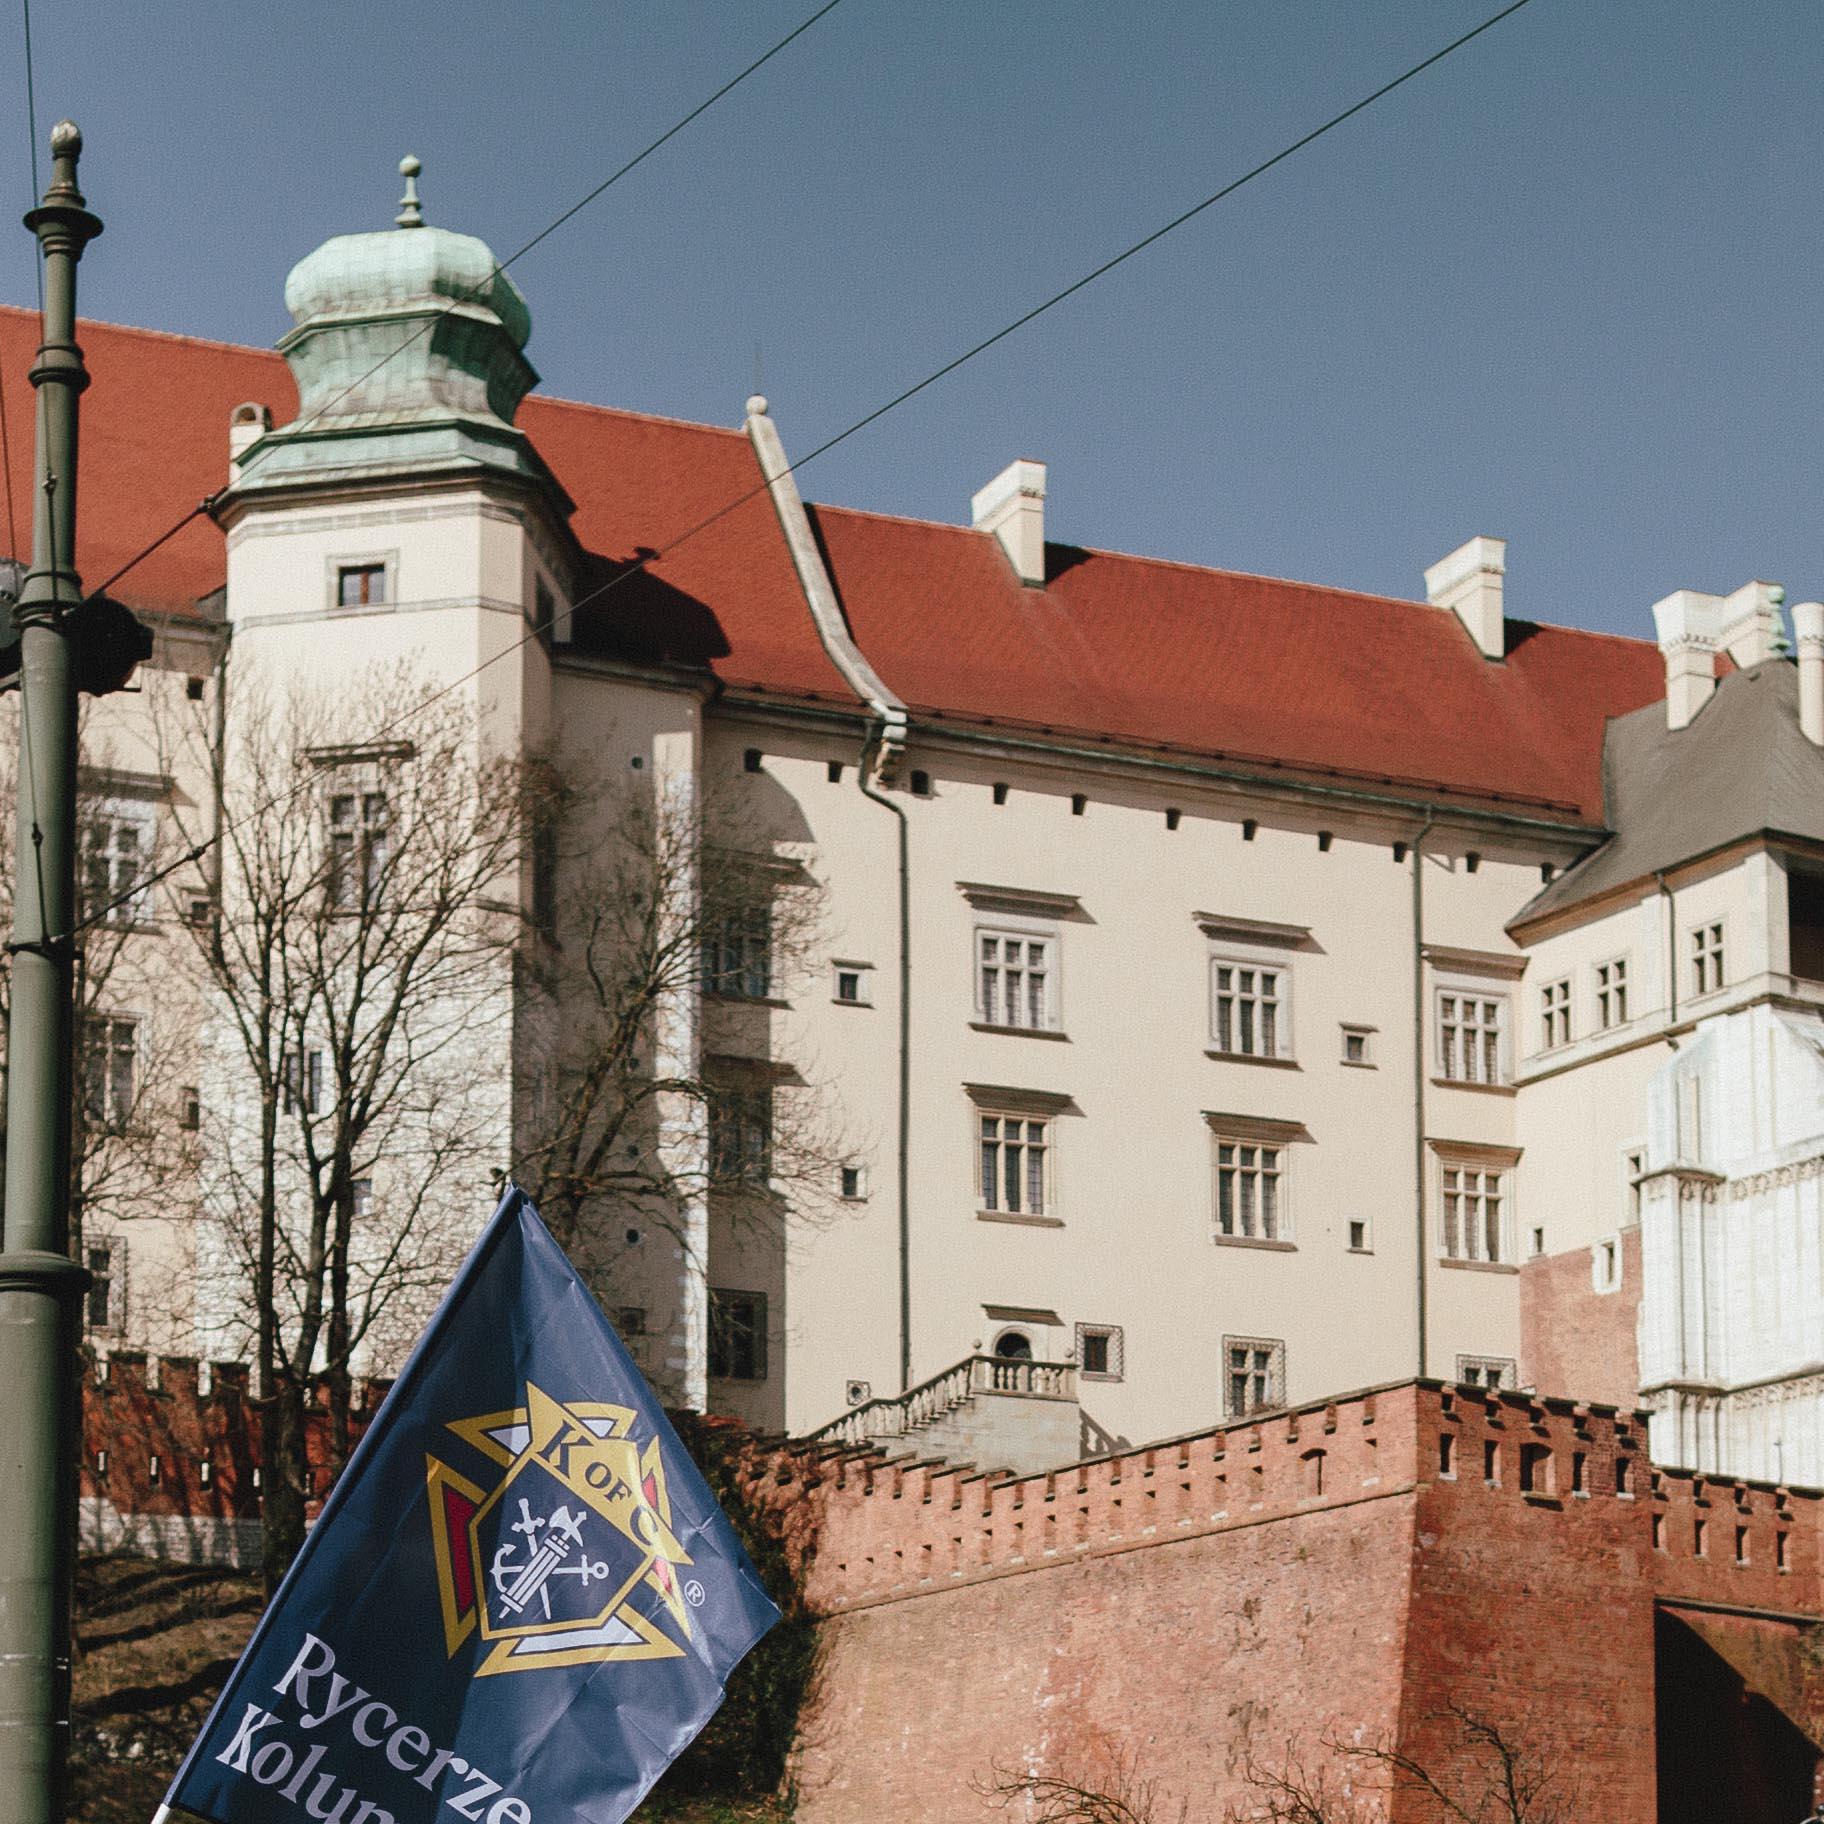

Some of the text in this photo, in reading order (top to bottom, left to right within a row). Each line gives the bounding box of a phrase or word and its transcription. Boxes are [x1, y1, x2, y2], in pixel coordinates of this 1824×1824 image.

[536, 1420, 659, 1547] K OF C
